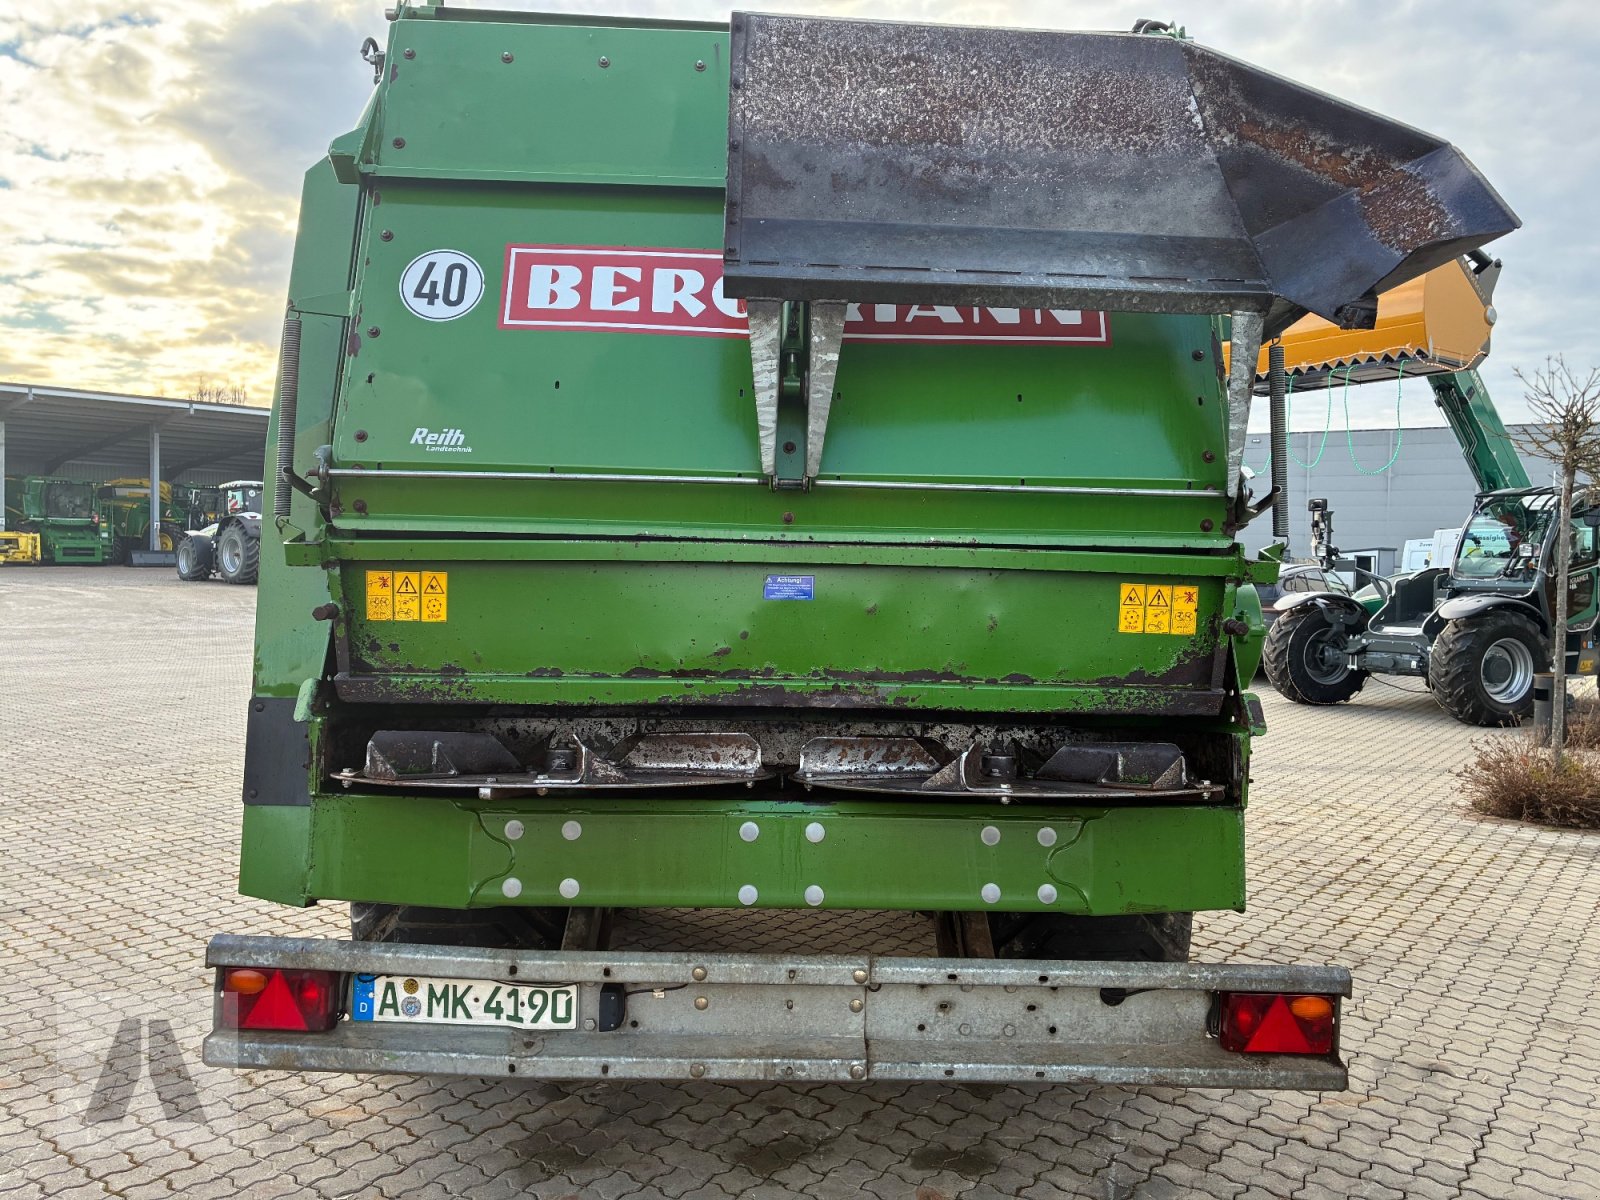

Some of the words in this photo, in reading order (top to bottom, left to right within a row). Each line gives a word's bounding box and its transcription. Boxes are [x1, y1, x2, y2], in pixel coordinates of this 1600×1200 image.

[413, 261, 468, 307] 40
[409, 427, 465, 446] Reith
[425, 445, 473, 453] Landtechnik
[359, 1002, 367, 1013] D
[378, 981, 400, 1016] A
[427, 983, 474, 1019] MK
[484, 986, 573, 1024] 4190
